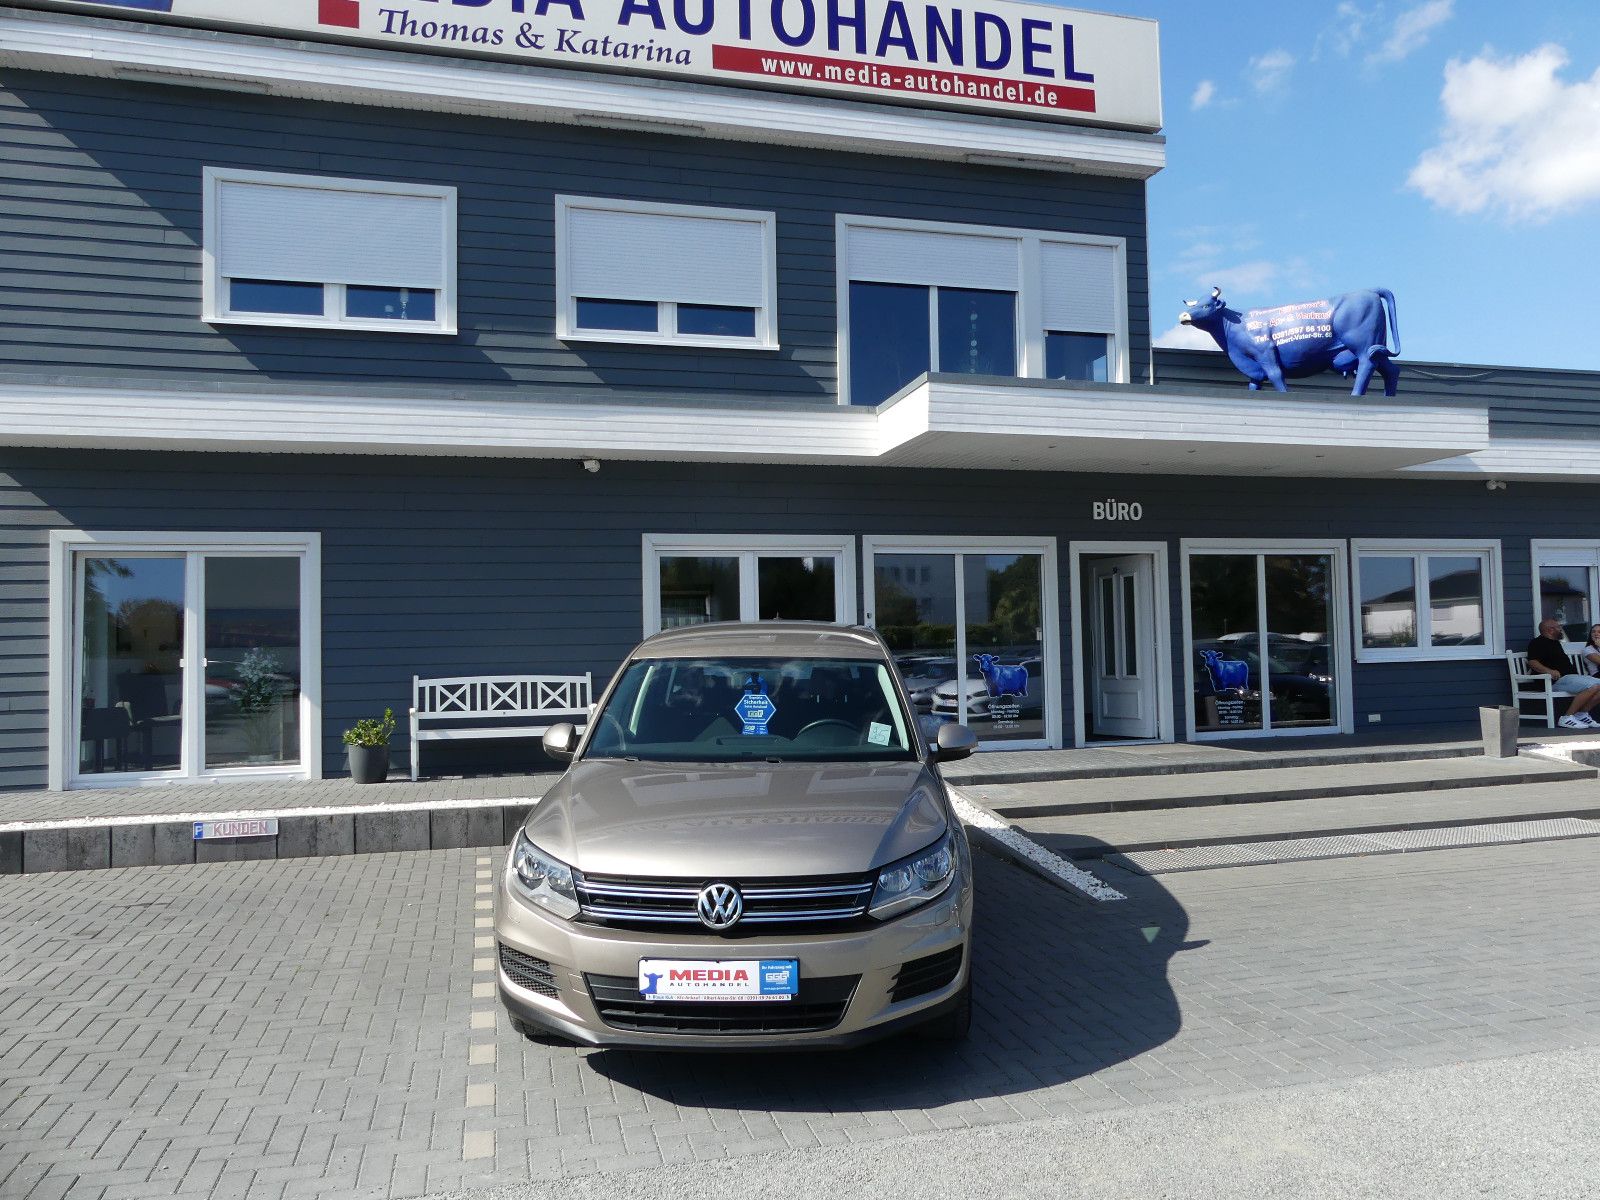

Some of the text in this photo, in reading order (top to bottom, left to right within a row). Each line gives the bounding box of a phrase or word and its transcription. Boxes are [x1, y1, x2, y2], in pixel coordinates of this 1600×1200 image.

[378, 8, 504, 46] Thomas
[515, 22, 545, 50] &
[554, 27, 693, 66] Katarina
[761, 57, 1058, 106] www.media-autohandel.de
[1317, 324, 1331, 332] 100
[1093, 498, 1143, 521] BÜRO
[213, 820, 267, 837] KUNDEN
[669, 969, 748, 981] MEDIA
